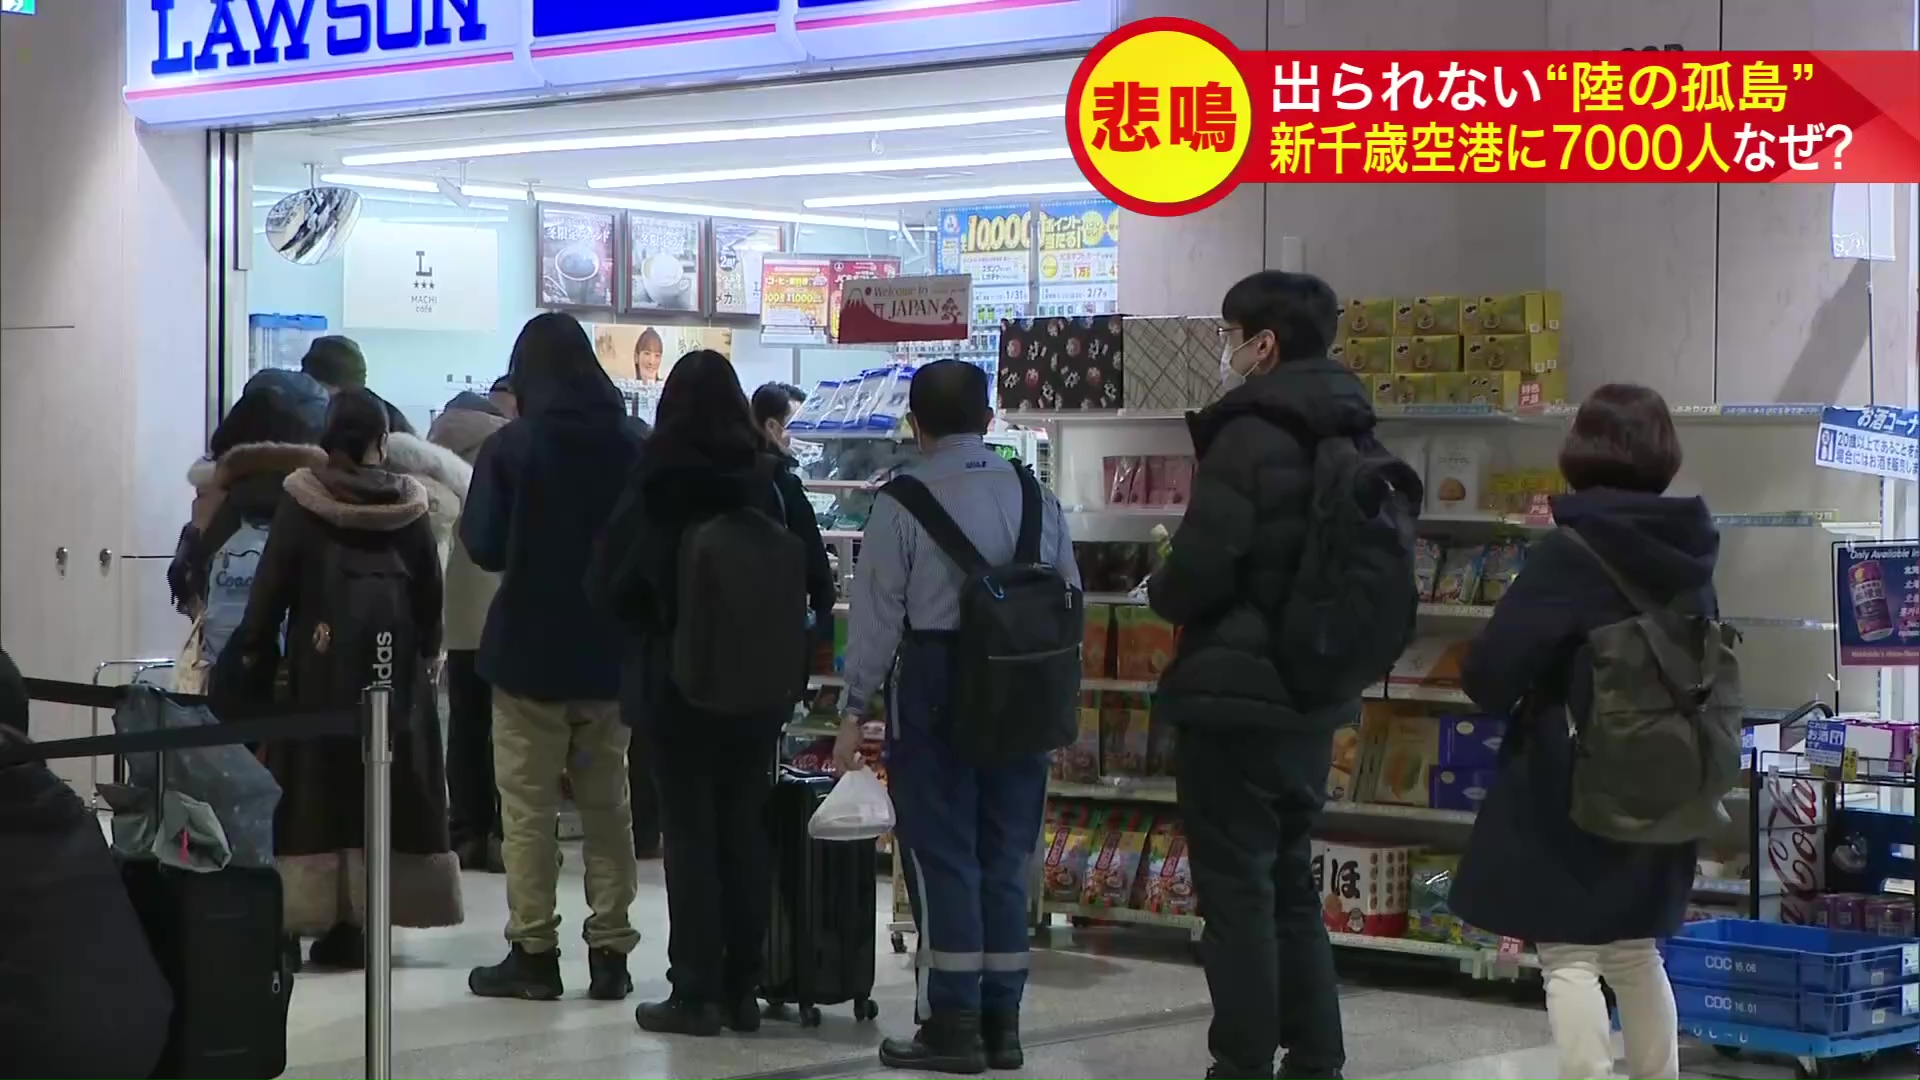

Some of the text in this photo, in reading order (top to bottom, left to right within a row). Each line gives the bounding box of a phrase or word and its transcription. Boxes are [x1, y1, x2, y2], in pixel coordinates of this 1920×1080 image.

[152, 0, 487, 75] LAWSON
[416, 250, 433, 276] L
[874, 285, 928, 297] Welcome to
[411, 295, 438, 304] MACHI
[889, 299, 940, 319] JAPAN
[1850, 551, 1868, 560] Only
